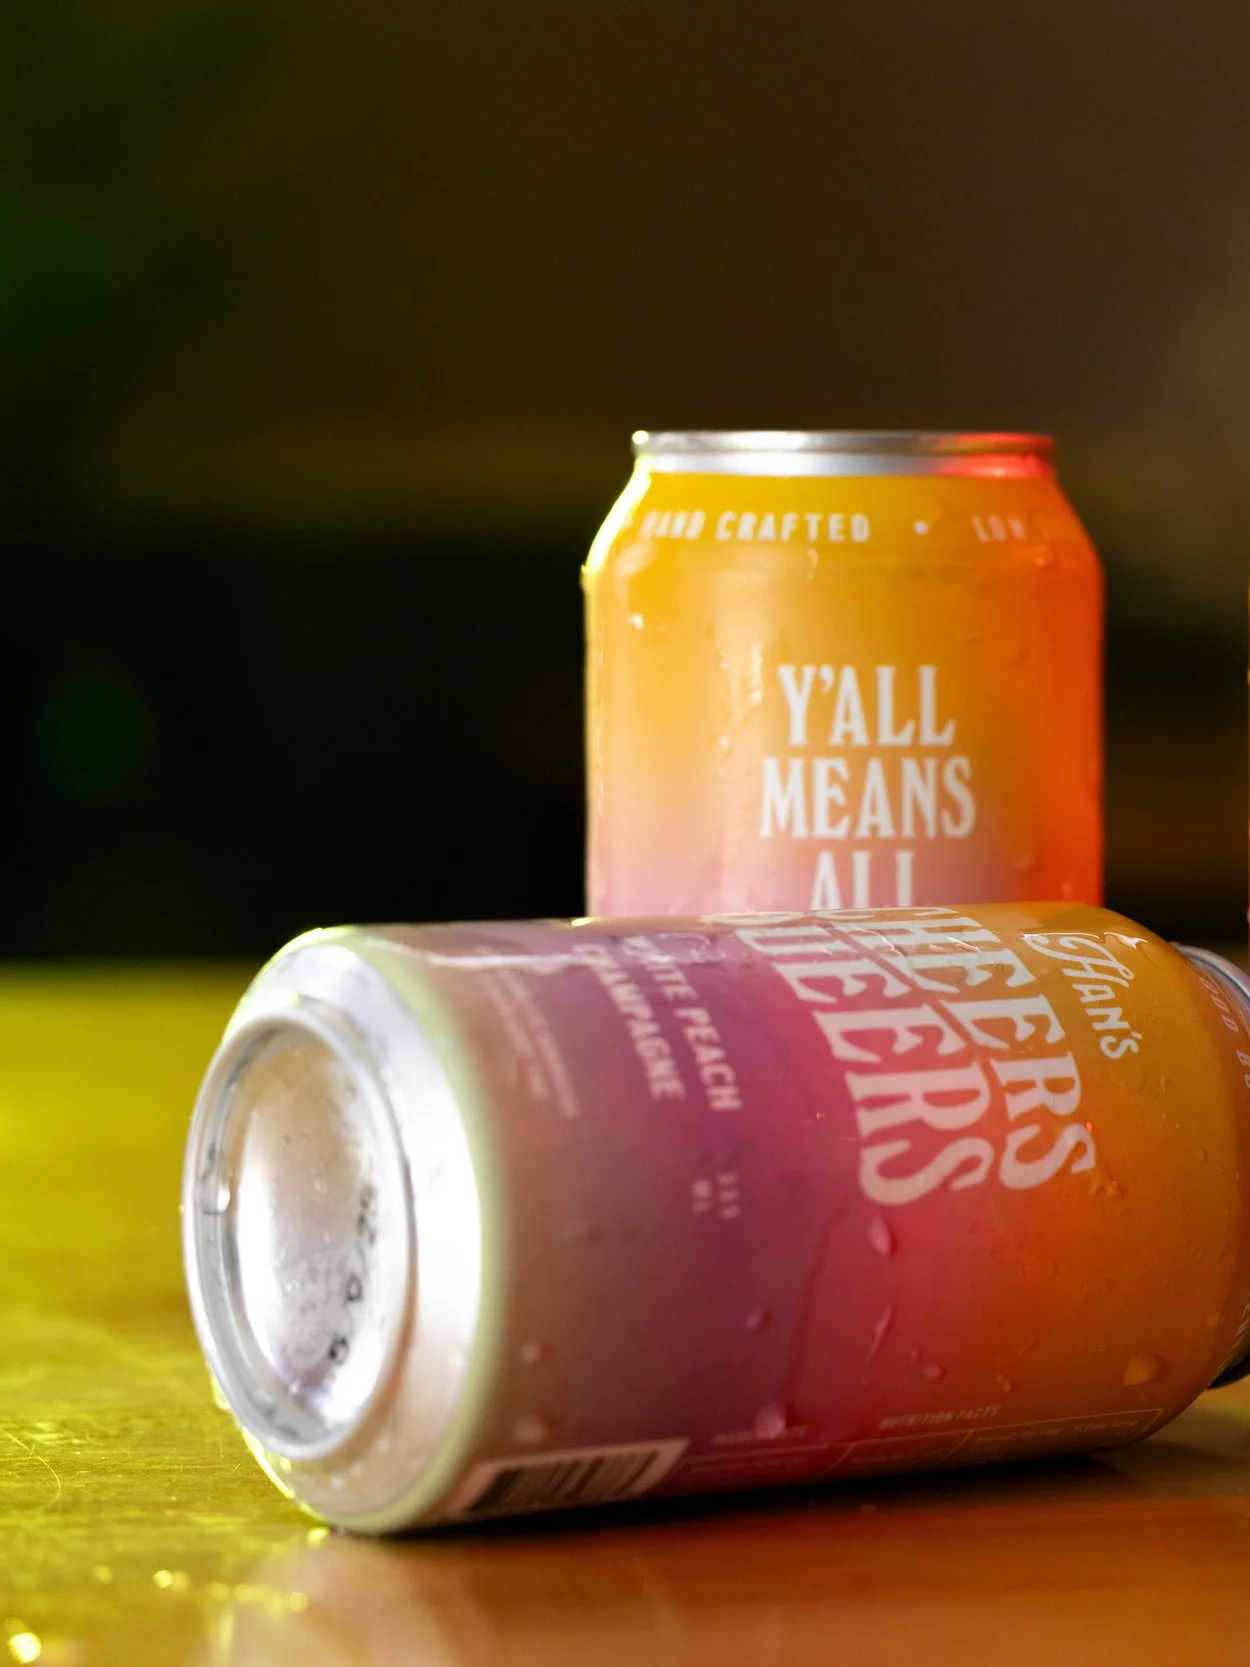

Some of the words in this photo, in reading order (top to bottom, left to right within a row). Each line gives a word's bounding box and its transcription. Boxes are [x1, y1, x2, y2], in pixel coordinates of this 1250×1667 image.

[714, 510, 870, 543] CRAFTED
[777, 664, 956, 747] Y'ALL
[758, 756, 977, 840] MEANS
[674, 1007, 743, 1112] PEACH
[697, 910, 995, 1206] QUEERS
[812, 906, 1097, 1190] CHEERS
